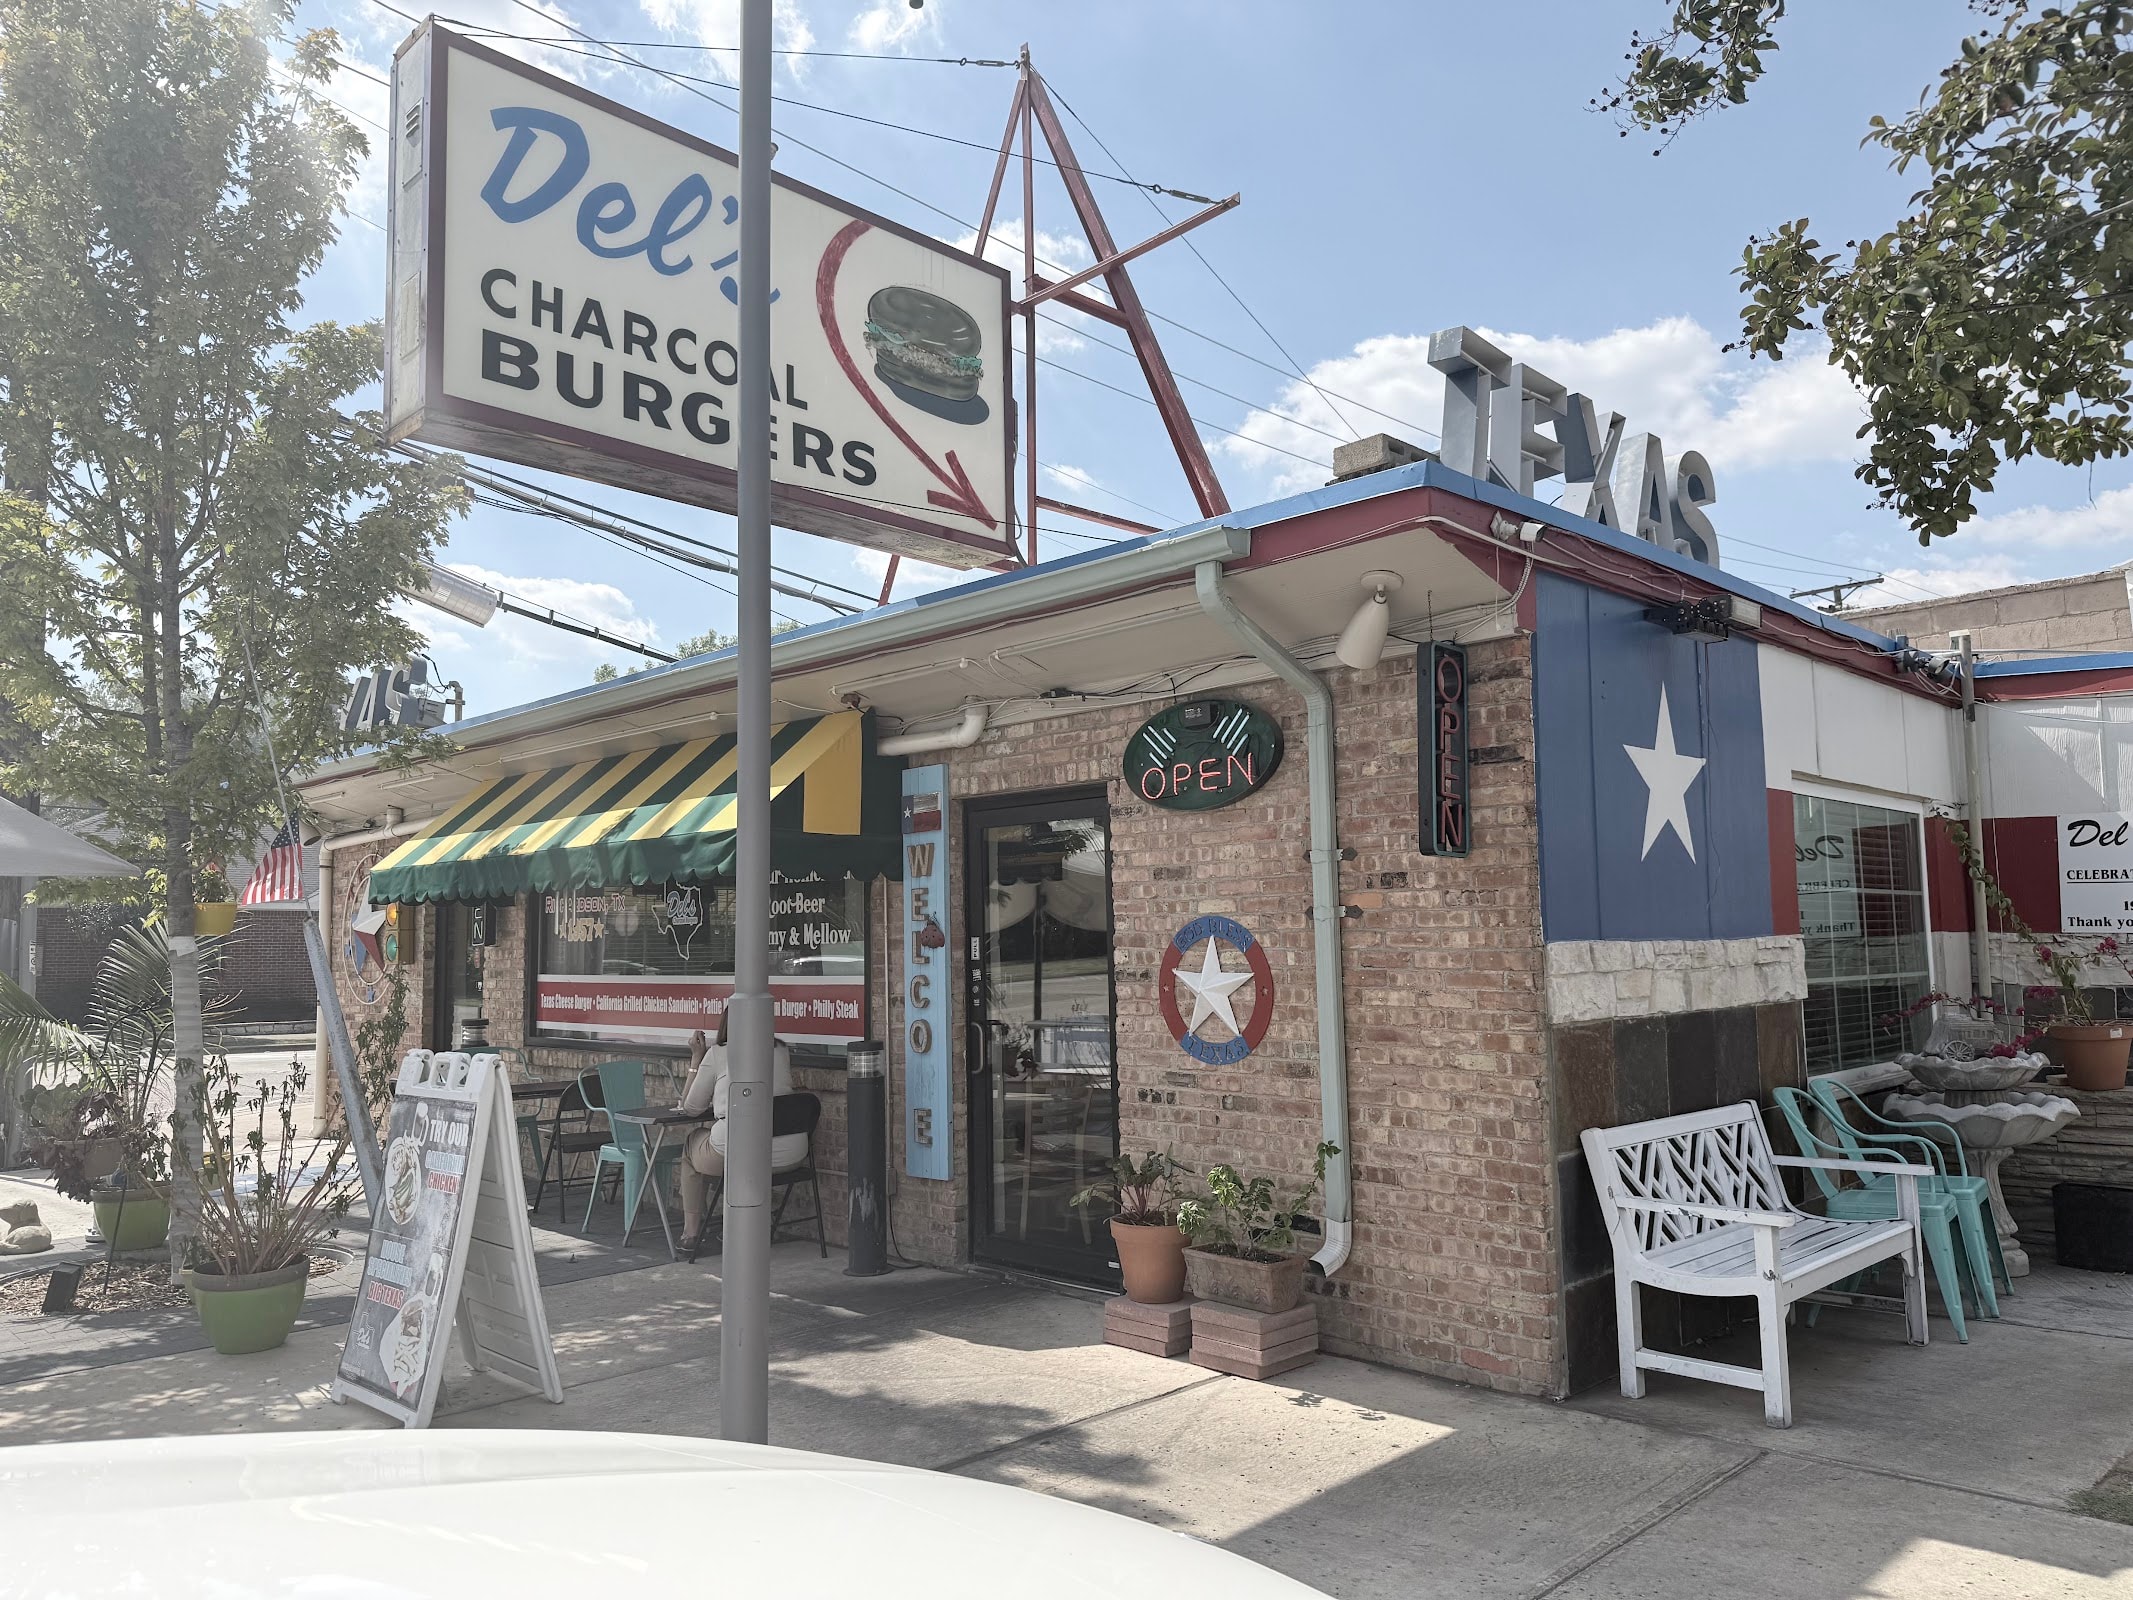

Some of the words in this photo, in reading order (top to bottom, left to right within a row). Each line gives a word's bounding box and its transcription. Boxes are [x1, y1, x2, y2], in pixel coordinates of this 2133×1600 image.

[480, 268, 808, 411] CHARCOL
[481, 328, 877, 487] BURGRS
[1428, 325, 1720, 569] TEXAS
[1437, 656, 1462, 847] OPEN
[1142, 752, 1254, 799] OPEN
[2067, 819, 2129, 847] Del
[612, 892, 626, 912] TX
[666, 890, 697, 918] Del's
[769, 896, 796, 919] oot
[796, 893, 826, 914] Beer
[1176, 922, 1203, 949] GOD
[1208, 918, 1251, 948] BLESS
[2067, 916, 2112, 927] Thank
[789, 926, 800, 946] &
[803, 922, 851, 950] Mellow
[541, 993, 555, 1009] Texas
[555, 993, 575, 1010] Cheese
[574, 994, 593, 1012] Burger
[596, 994, 623, 1011] California
[623, 995, 643, 1012] Grilled
[643, 996, 667, 1013] Chicken
[668, 996, 699, 1014] Sandwich
[703, 997, 723, 1015] Pattie
[781, 998, 808, 1020] Burger
[812, 999, 835, 1020] Philly
[835, 999, 859, 1019] Steak
[1187, 1037, 1245, 1062] TEXAS
[429, 1120, 448, 1143] TRY
[447, 1121, 470, 1147] OUR
[427, 1170, 460, 1195] CHICKEN
[367, 1280, 383, 1304] BIG
[381, 1284, 405, 1310] TEXAS
